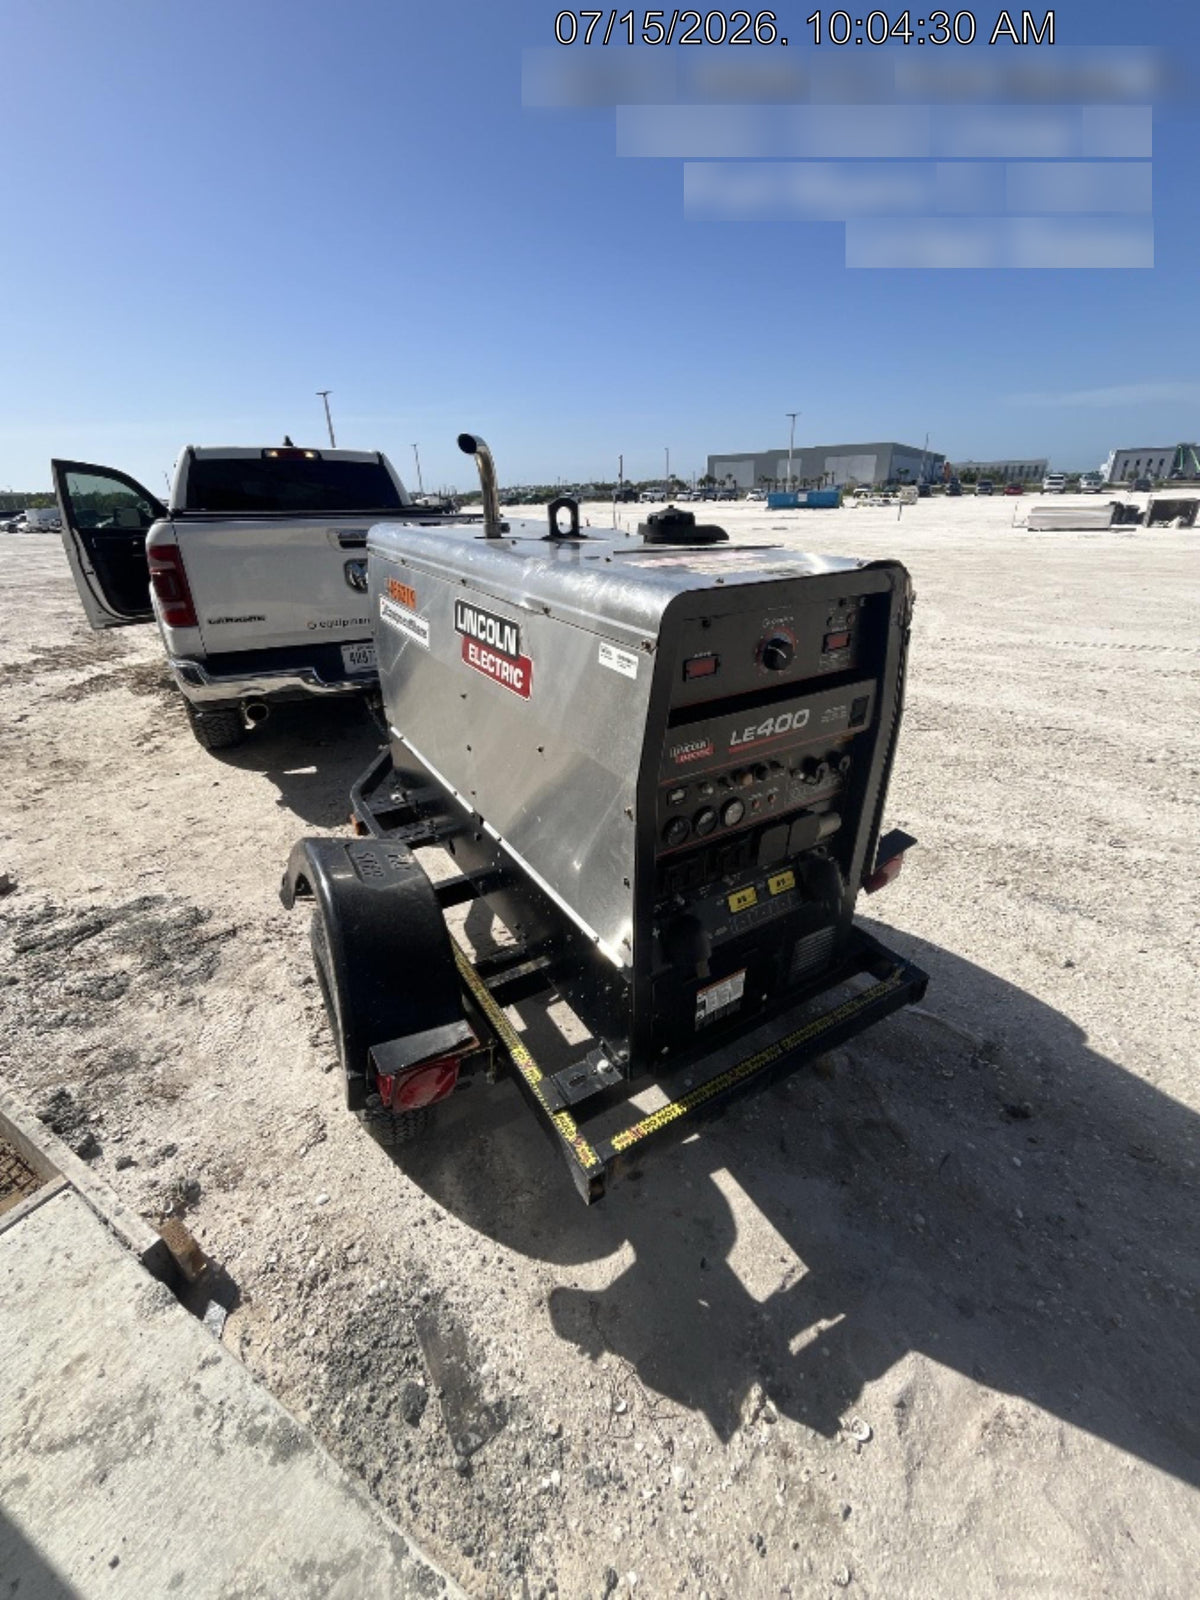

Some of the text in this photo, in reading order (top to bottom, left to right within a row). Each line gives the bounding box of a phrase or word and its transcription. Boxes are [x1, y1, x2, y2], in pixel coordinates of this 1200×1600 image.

[457, 605, 517, 656] LINCOLN
[468, 643, 524, 689] ELECTRIC
[730, 709, 810, 745] LE400
